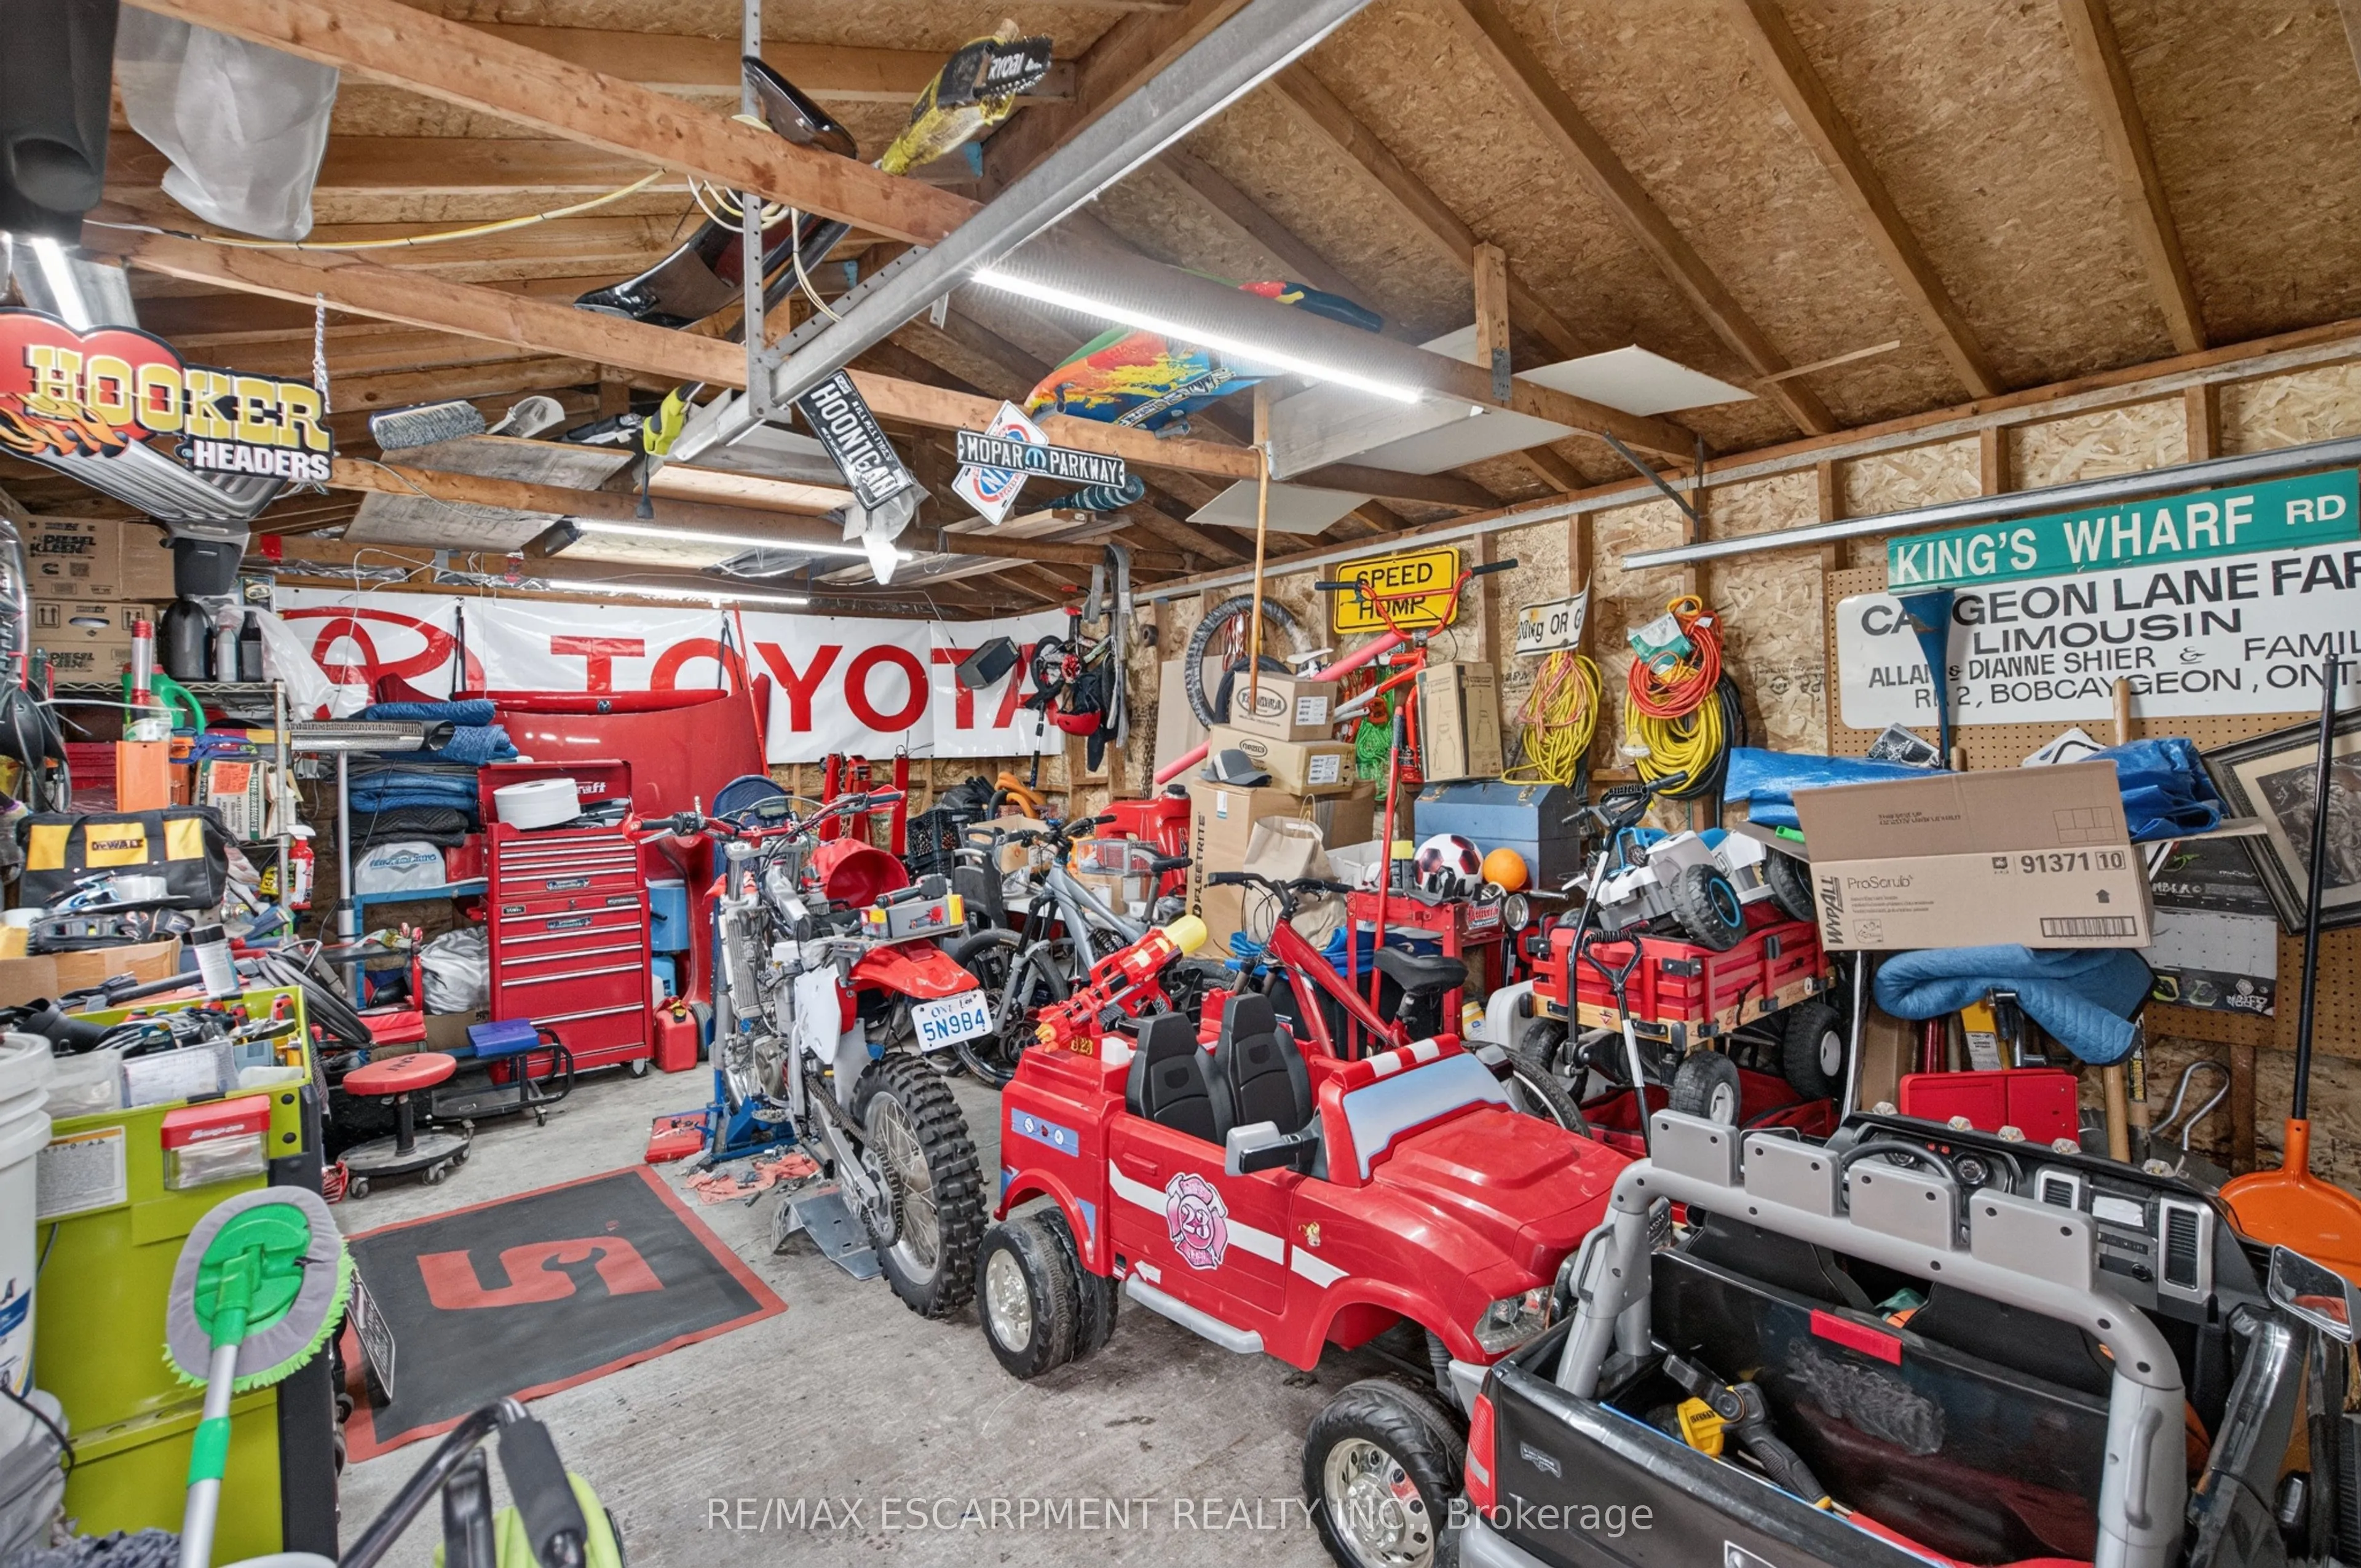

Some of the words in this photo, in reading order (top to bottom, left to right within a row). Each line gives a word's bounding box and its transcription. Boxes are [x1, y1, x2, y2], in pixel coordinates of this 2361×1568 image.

[26, 344, 330, 452] HOOKER
[193, 440, 331, 481] HEADERS
[967, 436, 1024, 469] MOPAR
[1049, 451, 1117, 484] PARKWAY
[1897, 528, 2037, 584] KING'S
[2063, 496, 2254, 564] WHARF
[2286, 495, 2346, 525] RD
[1356, 563, 1433, 588] SPEED
[2113, 563, 2259, 611] LANE
[1551, 611, 1568, 635] OR
[1974, 608, 2241, 656] LIMOUSIN
[550, 635, 1059, 733] TOYOTA
[1969, 653, 2055, 680] DIANNE
[2064, 646, 2156, 674] SHIER
[2020, 852, 2090, 873] 91371
[2098, 853, 2122, 869] 10
